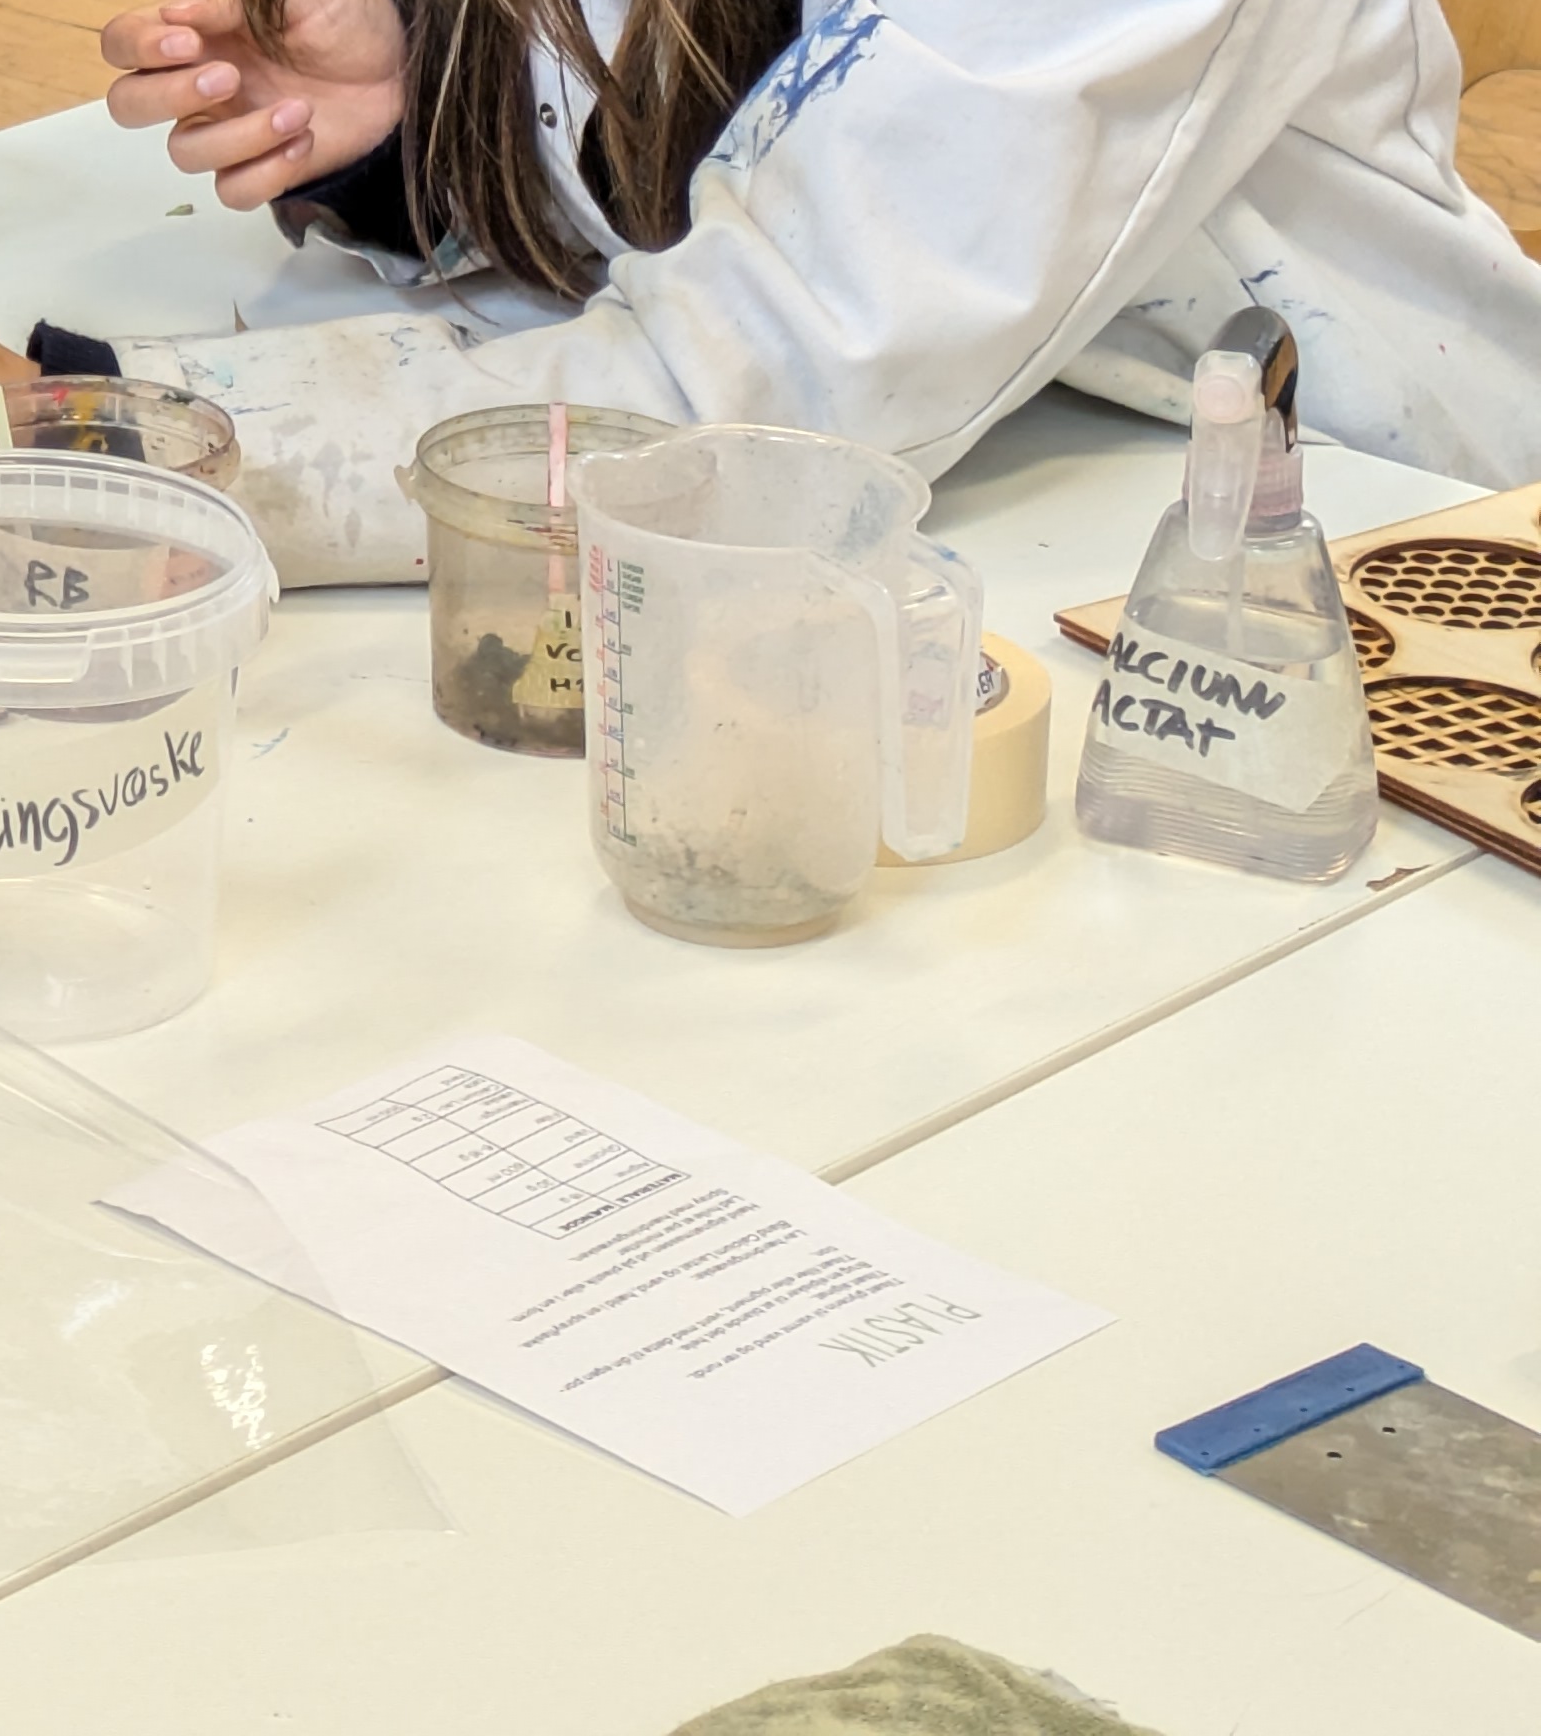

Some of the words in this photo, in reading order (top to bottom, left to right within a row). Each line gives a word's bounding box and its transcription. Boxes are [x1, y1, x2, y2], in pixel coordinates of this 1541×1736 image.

[24, 560, 90, 610] RB
[1108, 632, 1286, 720] ALCIUM
[1092, 679, 1236, 758] ACTAT
[817, 1292, 983, 1368] PLASTIK
